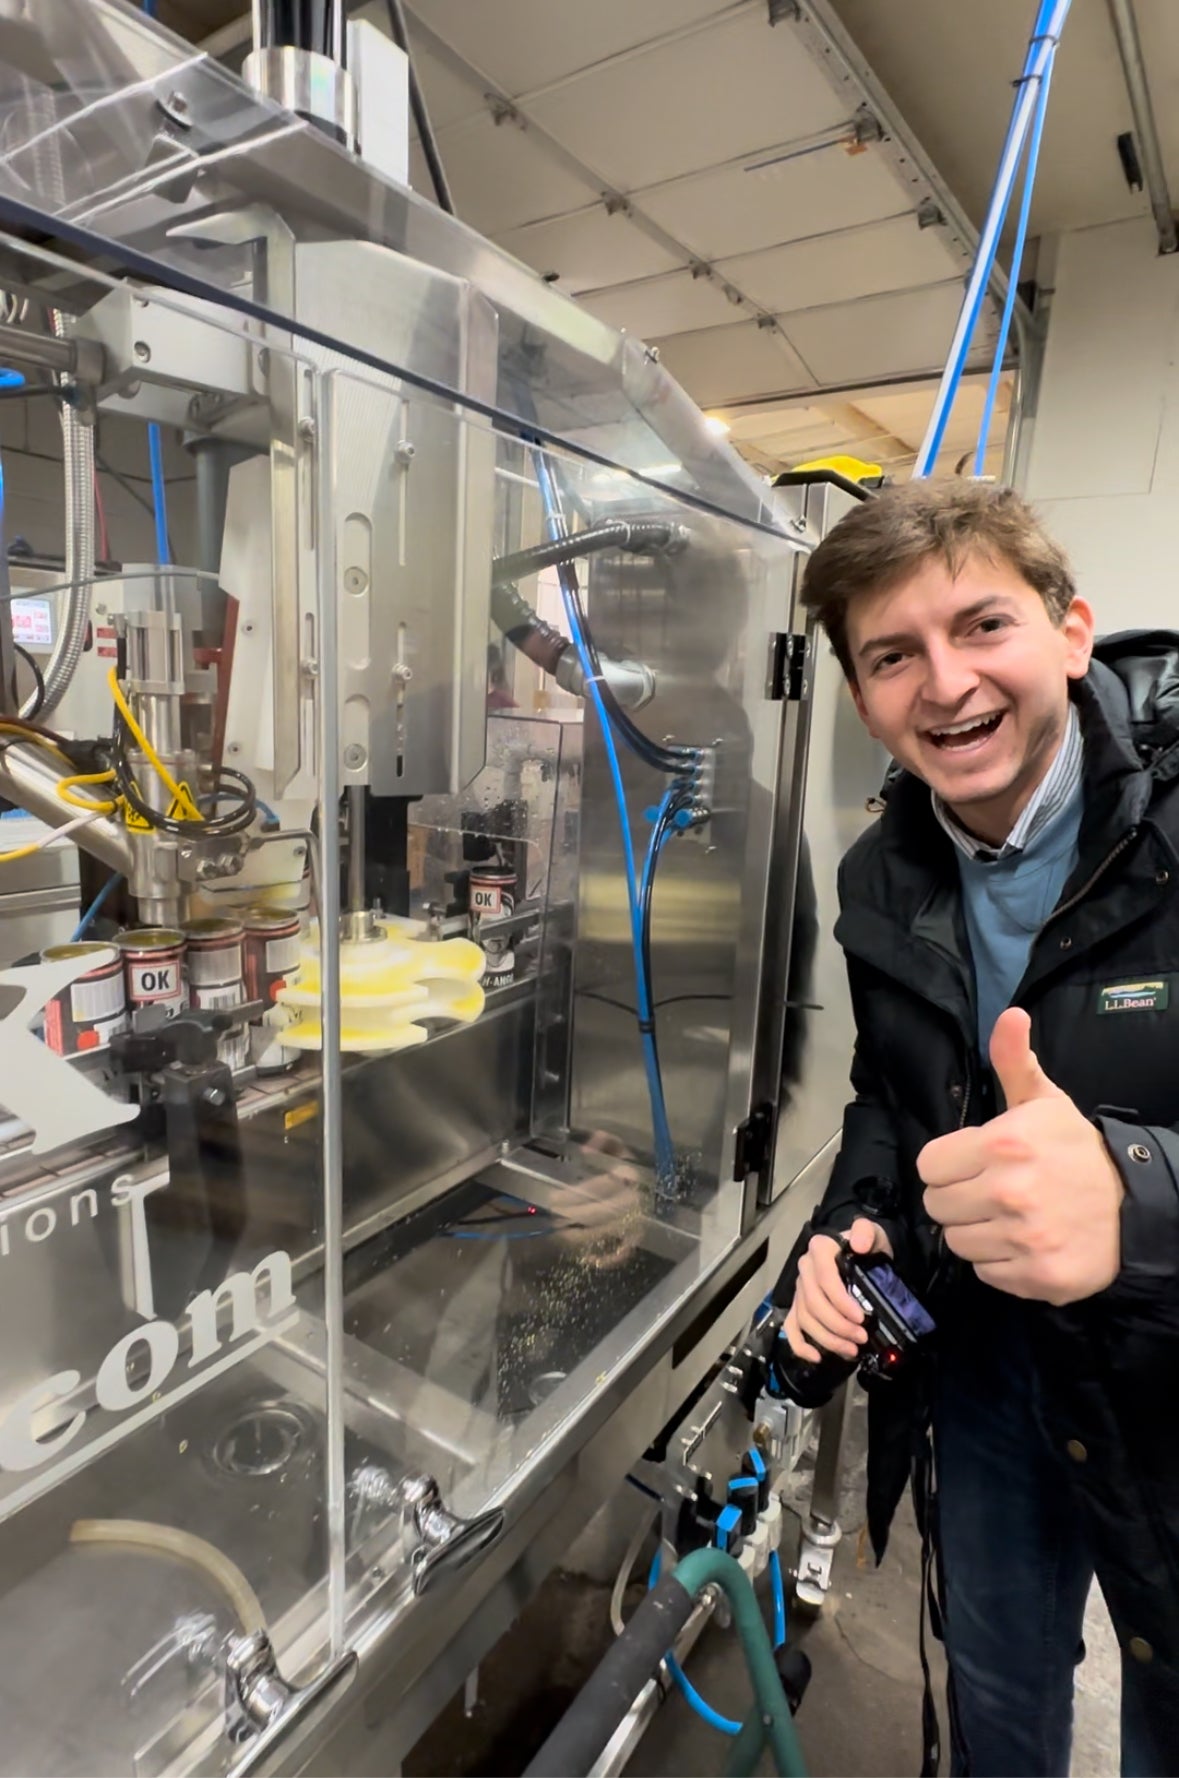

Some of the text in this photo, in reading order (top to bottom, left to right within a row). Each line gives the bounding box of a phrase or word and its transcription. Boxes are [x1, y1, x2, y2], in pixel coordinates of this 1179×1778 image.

[475, 892, 492, 907] OK
[141, 969, 170, 991] OK
[0, 1250, 297, 1471] com
